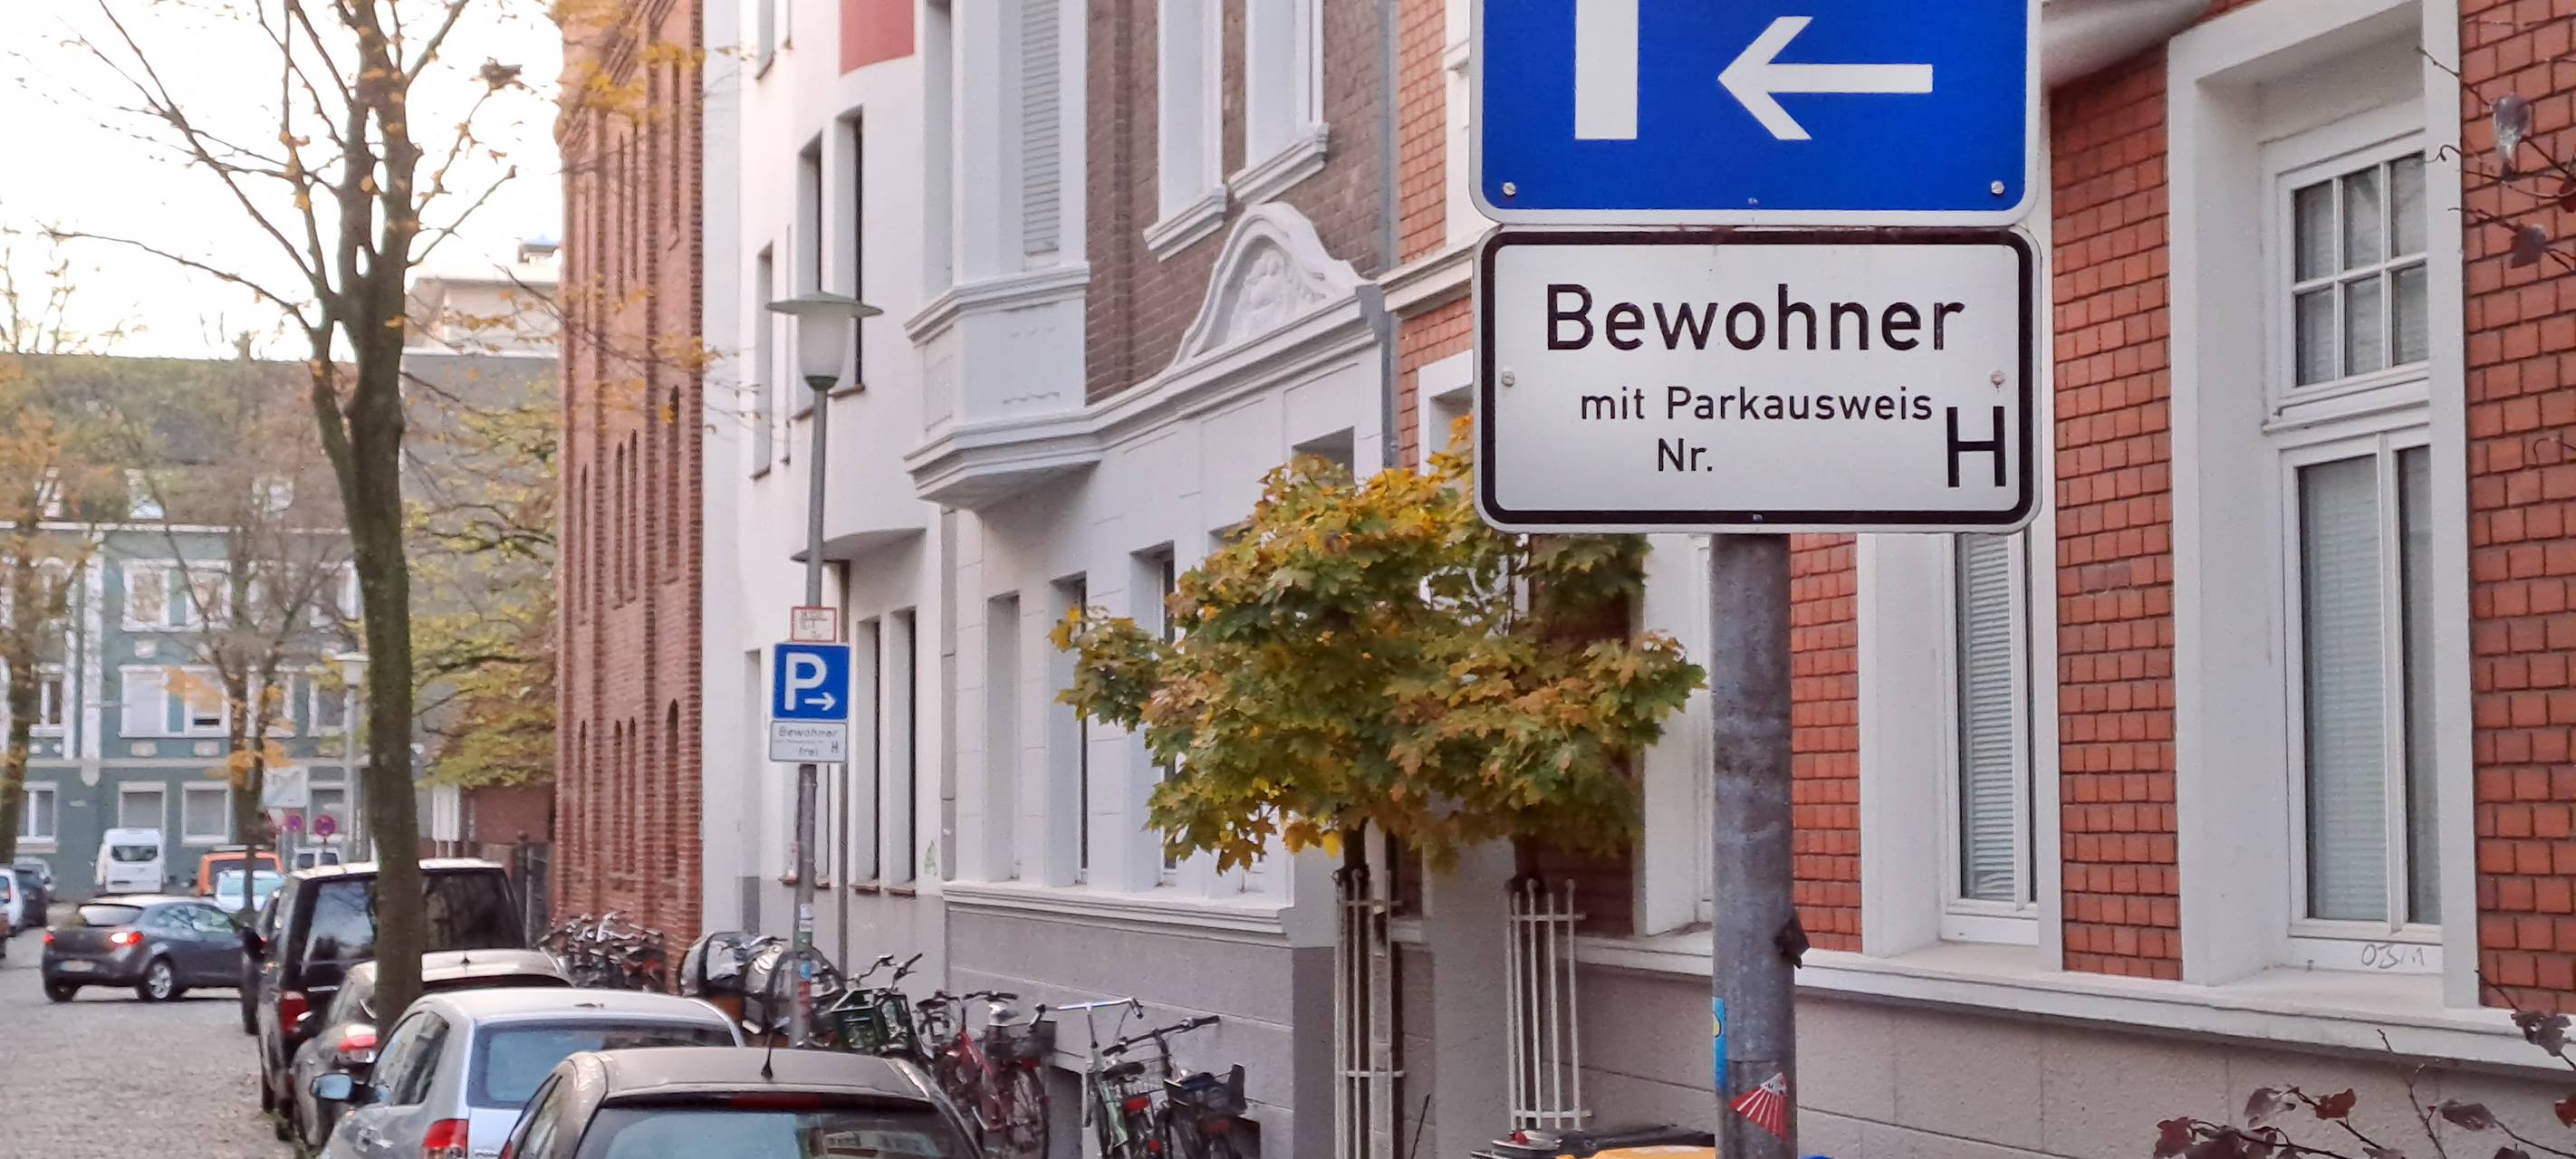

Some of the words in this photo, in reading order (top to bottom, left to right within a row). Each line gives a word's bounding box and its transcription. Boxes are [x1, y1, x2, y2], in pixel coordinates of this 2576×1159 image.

[1546, 283, 1965, 350] Bewohner
[1581, 387, 1645, 420] mit
[1668, 387, 1932, 420] Parkausweis
[1658, 438, 1713, 472] Nr.
[1946, 406, 2006, 488] H
[784, 652, 827, 711] P
[779, 726, 840, 737] Bewohner
[831, 741, 839, 753] H
